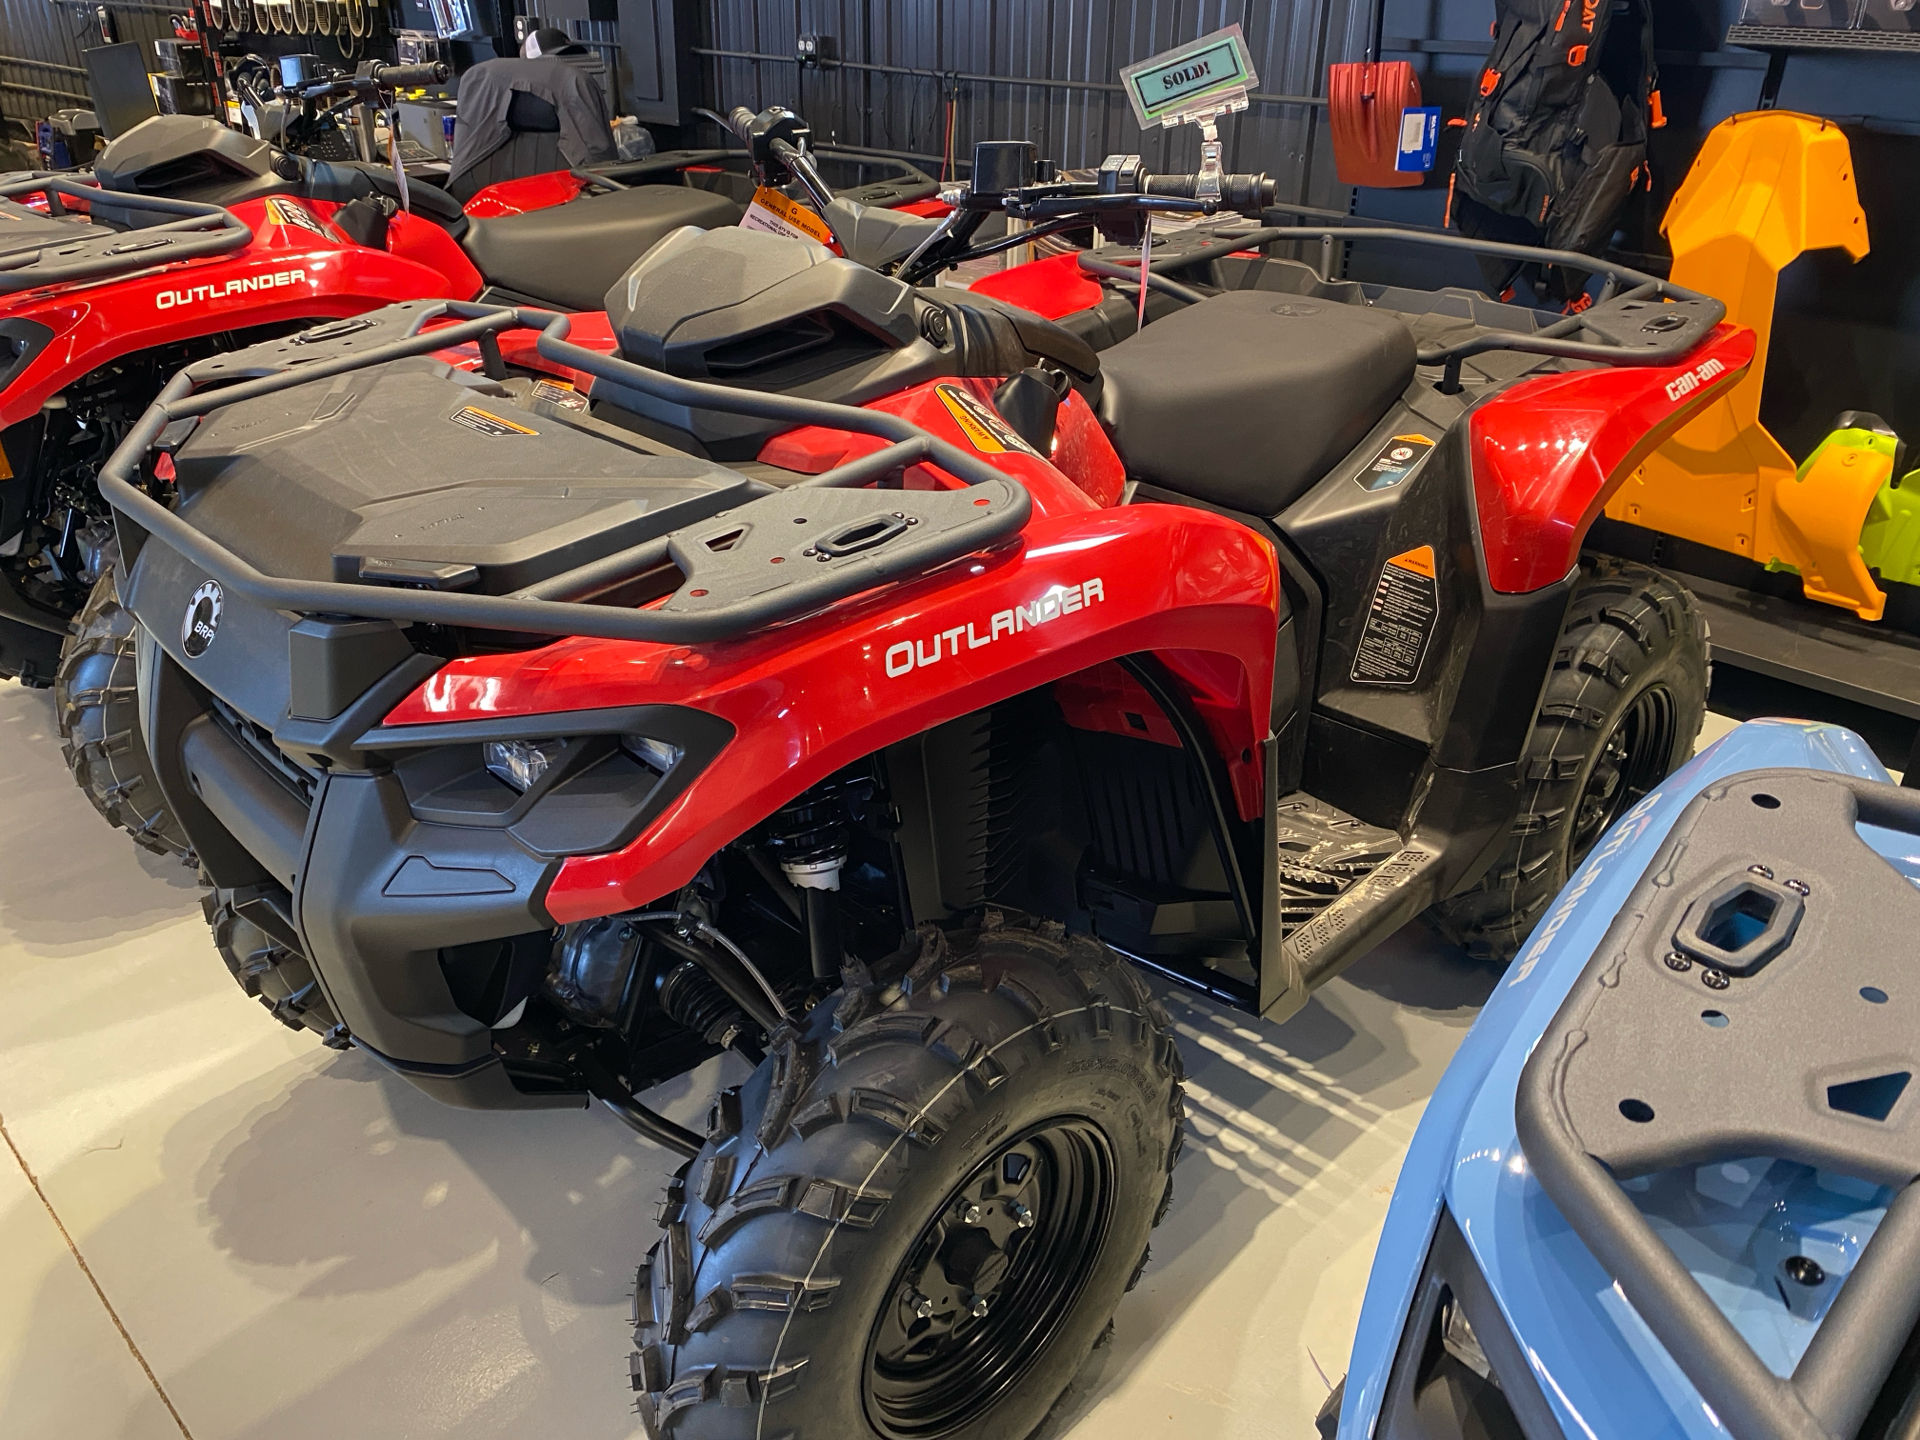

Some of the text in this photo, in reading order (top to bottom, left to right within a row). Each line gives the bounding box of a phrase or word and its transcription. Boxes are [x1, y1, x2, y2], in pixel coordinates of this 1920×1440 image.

[1162, 61, 1211, 90] SOLD!
[749, 213, 778, 234] RECREATIONAL
[760, 198, 821, 238] GENERAL USE MODEL
[791, 207, 798, 215] G
[156, 269, 306, 310] OUTLANDER
[194, 620, 215, 640] BRP
[885, 577, 1105, 678] OUTLANDER
[1507, 792, 1663, 988] OUTLANDER
